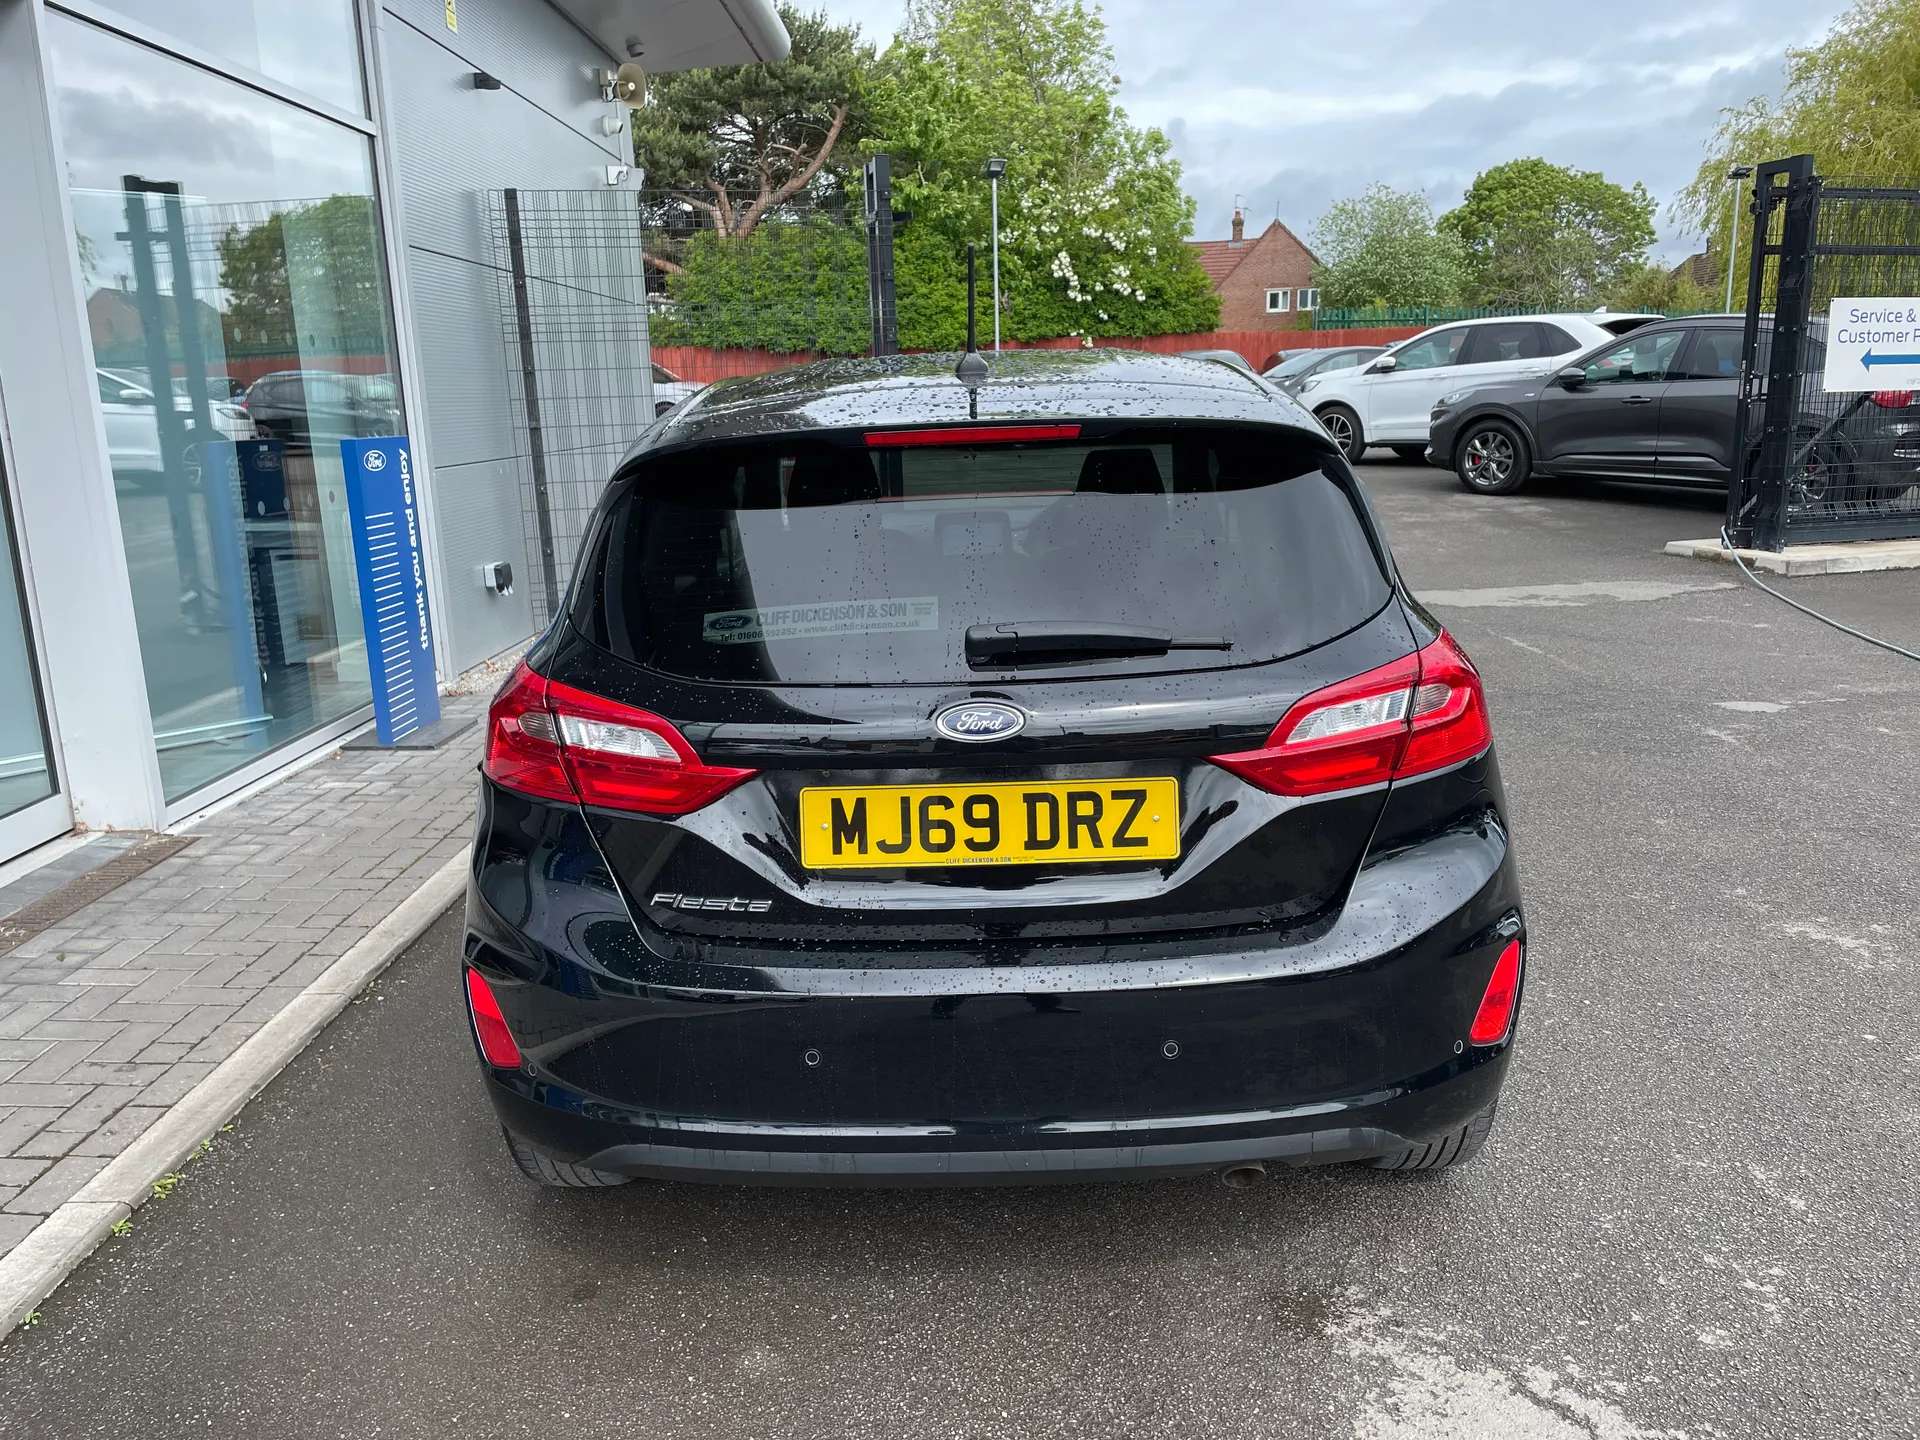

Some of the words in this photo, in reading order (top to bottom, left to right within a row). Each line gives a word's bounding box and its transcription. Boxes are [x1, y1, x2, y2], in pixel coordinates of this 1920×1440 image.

[1849, 308, 1903, 323] Service
[1906, 308, 1917, 323] &
[1837, 329, 1909, 343] Customer
[399, 448, 411, 505] enjoy
[405, 508, 417, 548] and
[412, 551, 423, 589] you
[416, 590, 429, 650] thank
[757, 610, 790, 626] CLIFF
[792, 604, 865, 624] DICKENSON
[868, 604, 878, 618] &
[880, 602, 907, 618] SON
[830, 793, 1000, 855] MJ69
[1023, 789, 1149, 851] DRZ
[649, 893, 773, 912] Fiesta
